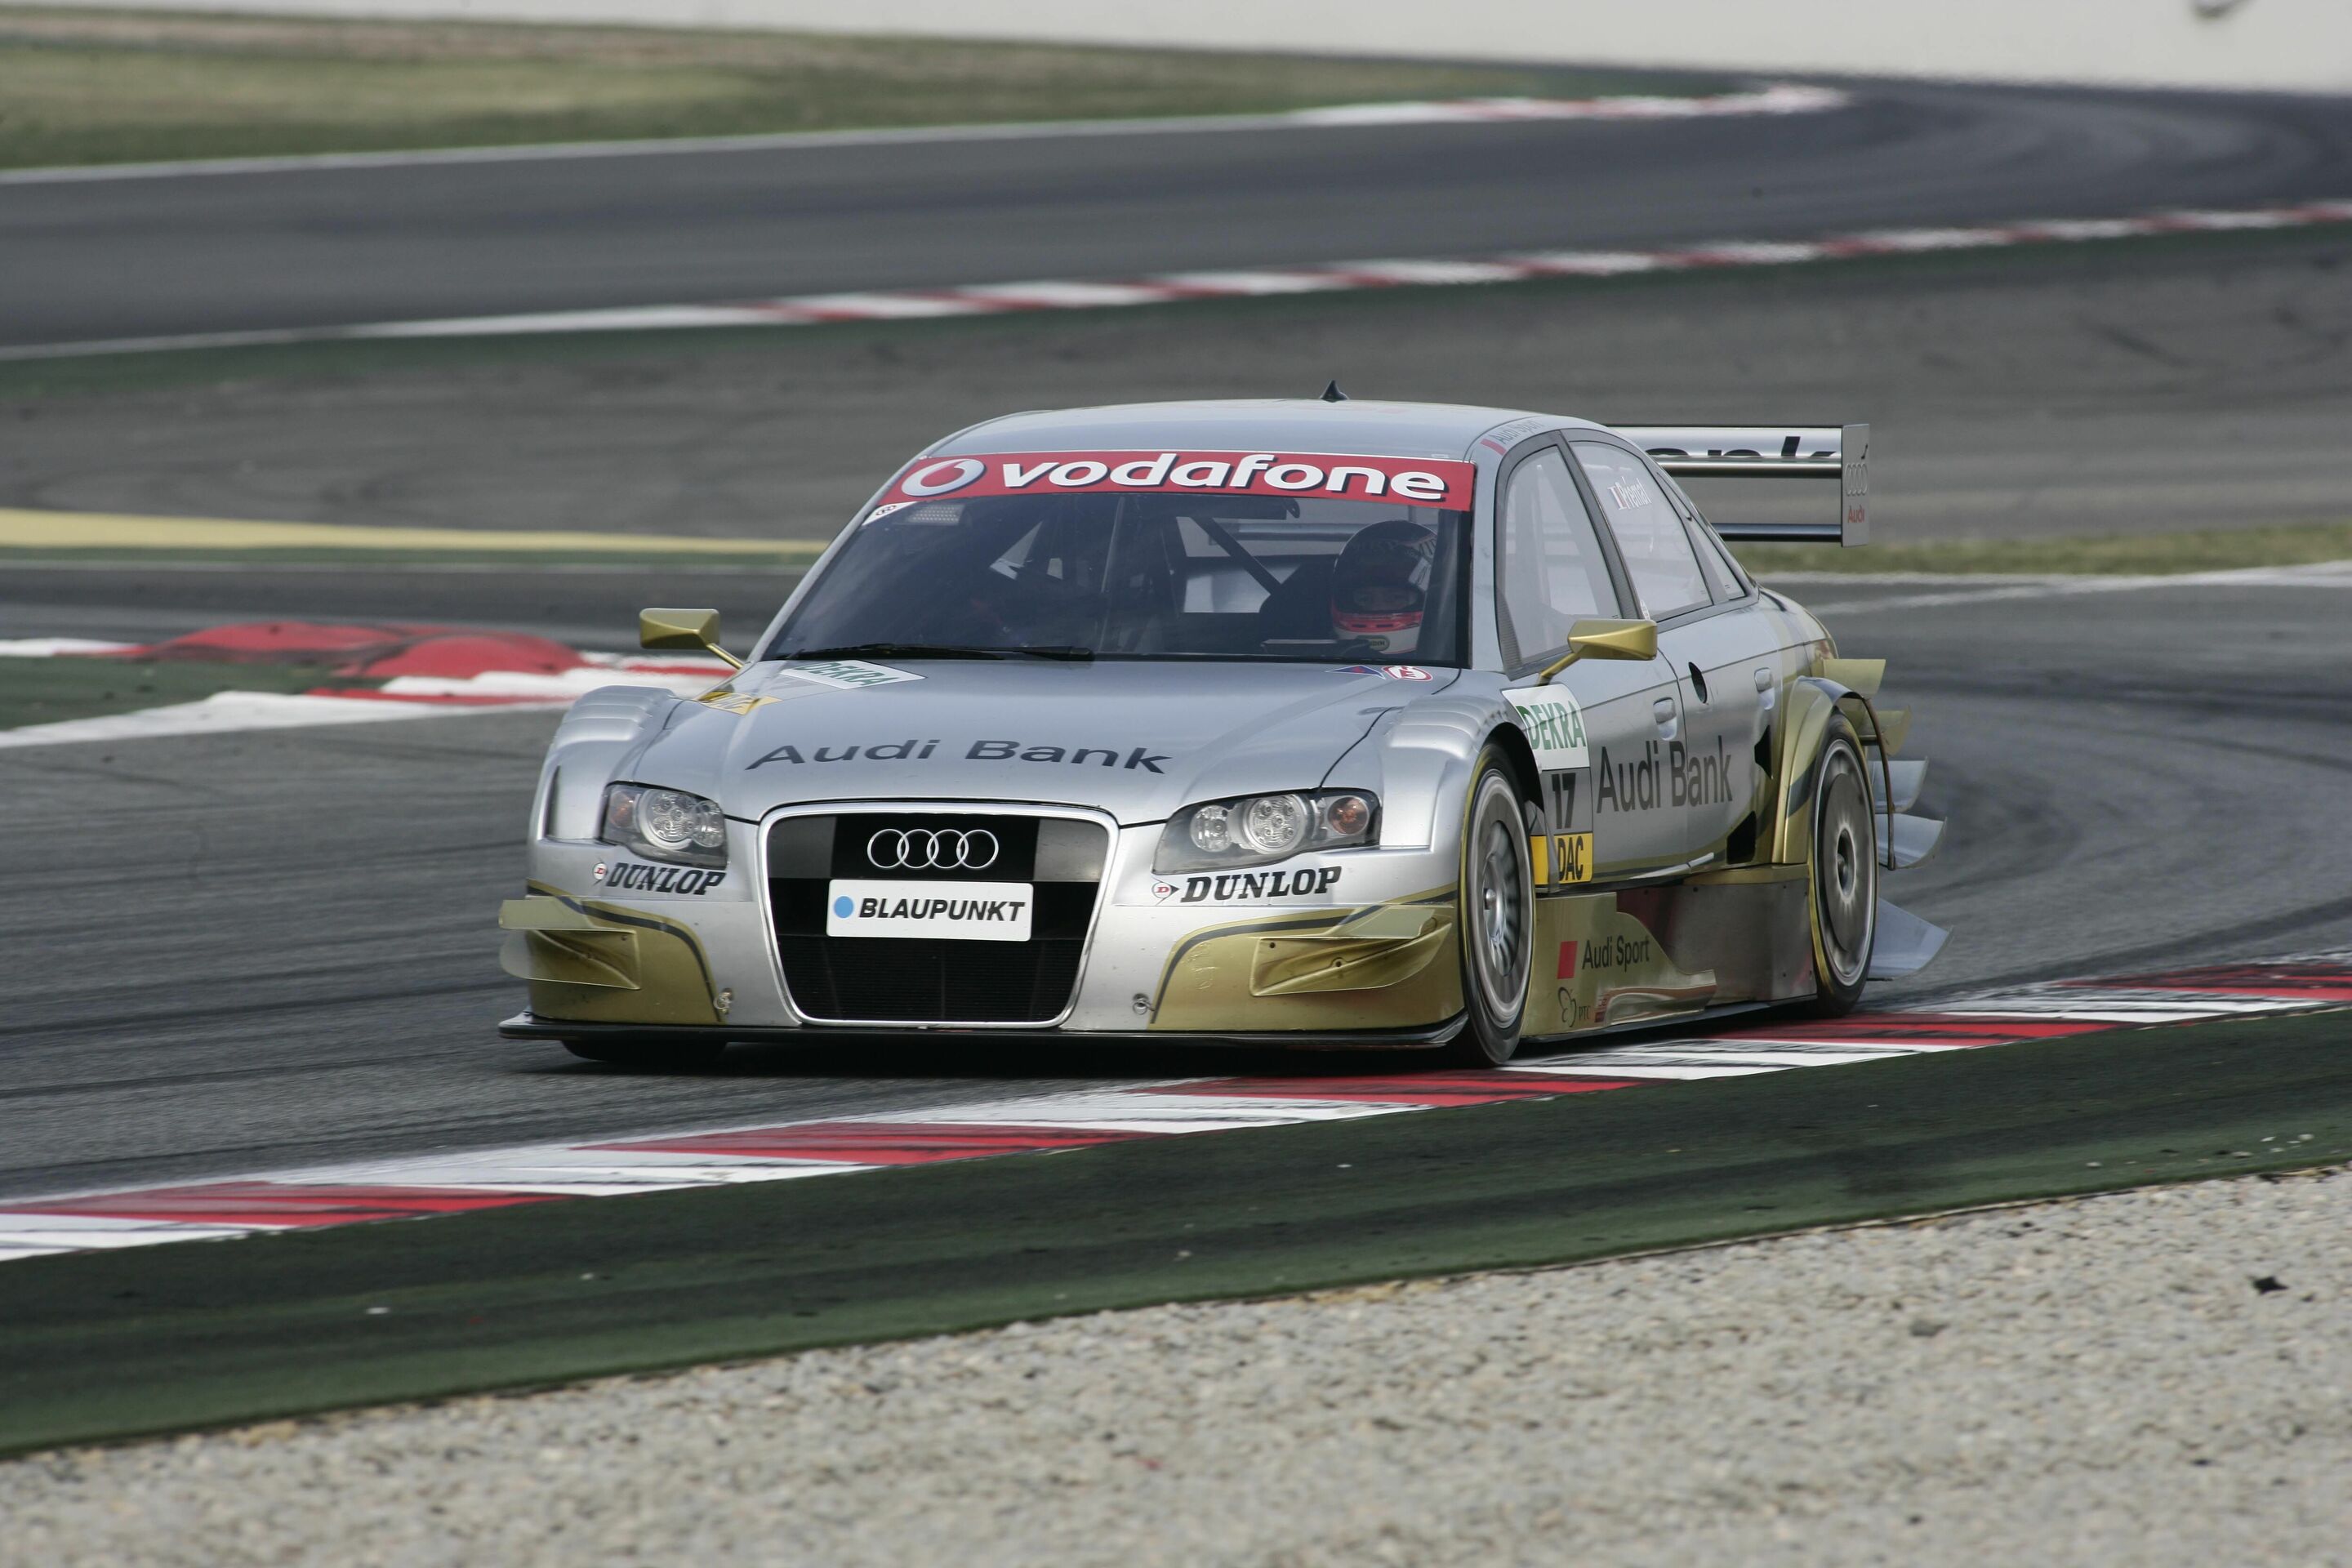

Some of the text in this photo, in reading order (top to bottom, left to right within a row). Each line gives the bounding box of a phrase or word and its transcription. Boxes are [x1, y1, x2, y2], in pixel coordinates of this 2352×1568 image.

[1002, 452, 1447, 501] vodafone
[1848, 506, 1864, 523] Audi
[792, 661, 900, 686] DEKRA
[1515, 700, 1587, 751] DEKRA
[744, 739, 1174, 775] Audi Bank
[1597, 735, 1734, 814] Audi Bank
[1550, 772, 1576, 830] 17
[606, 862, 727, 896] DUNLOP
[1180, 866, 1342, 903] DUNLOP
[858, 898, 1026, 921] BLAUPUNKT
[1581, 934, 1650, 973] Audi Sport
